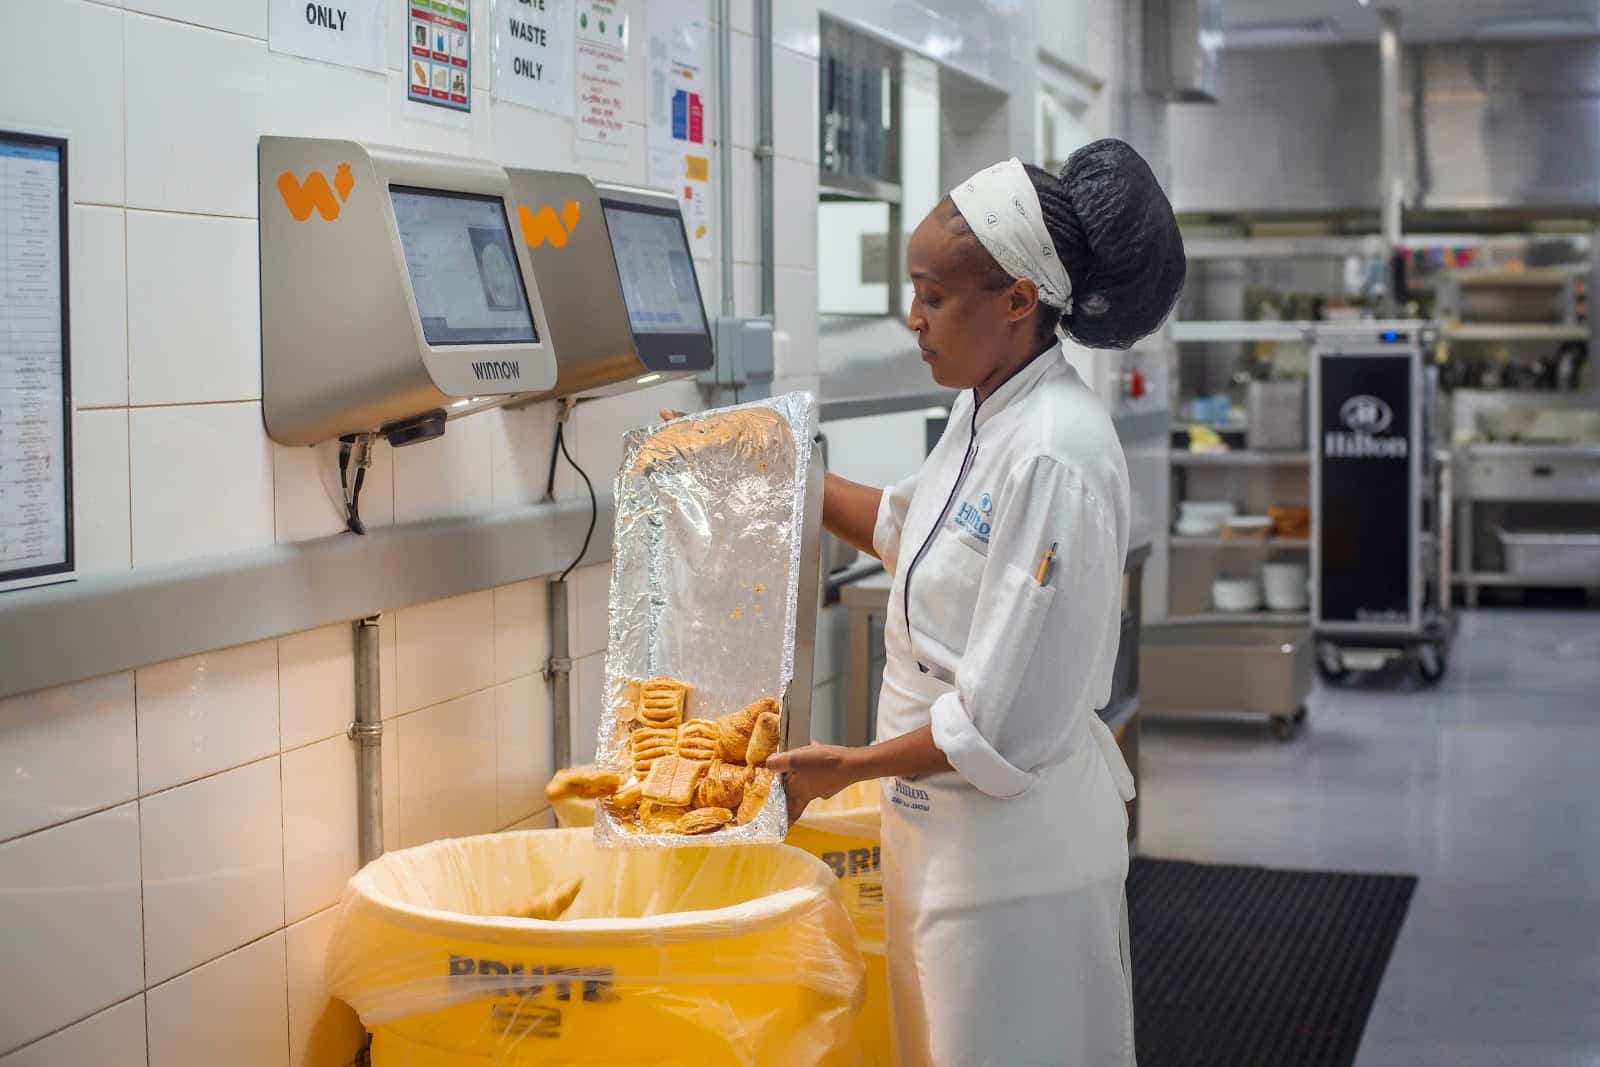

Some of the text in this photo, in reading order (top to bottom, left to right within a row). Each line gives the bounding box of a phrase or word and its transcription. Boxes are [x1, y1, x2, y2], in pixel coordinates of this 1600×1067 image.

[306, 3, 347, 31] ONLY
[510, 17, 547, 47] WASTE
[513, 56, 543, 81] ONLY
[1325, 431, 1408, 458] Hilton
